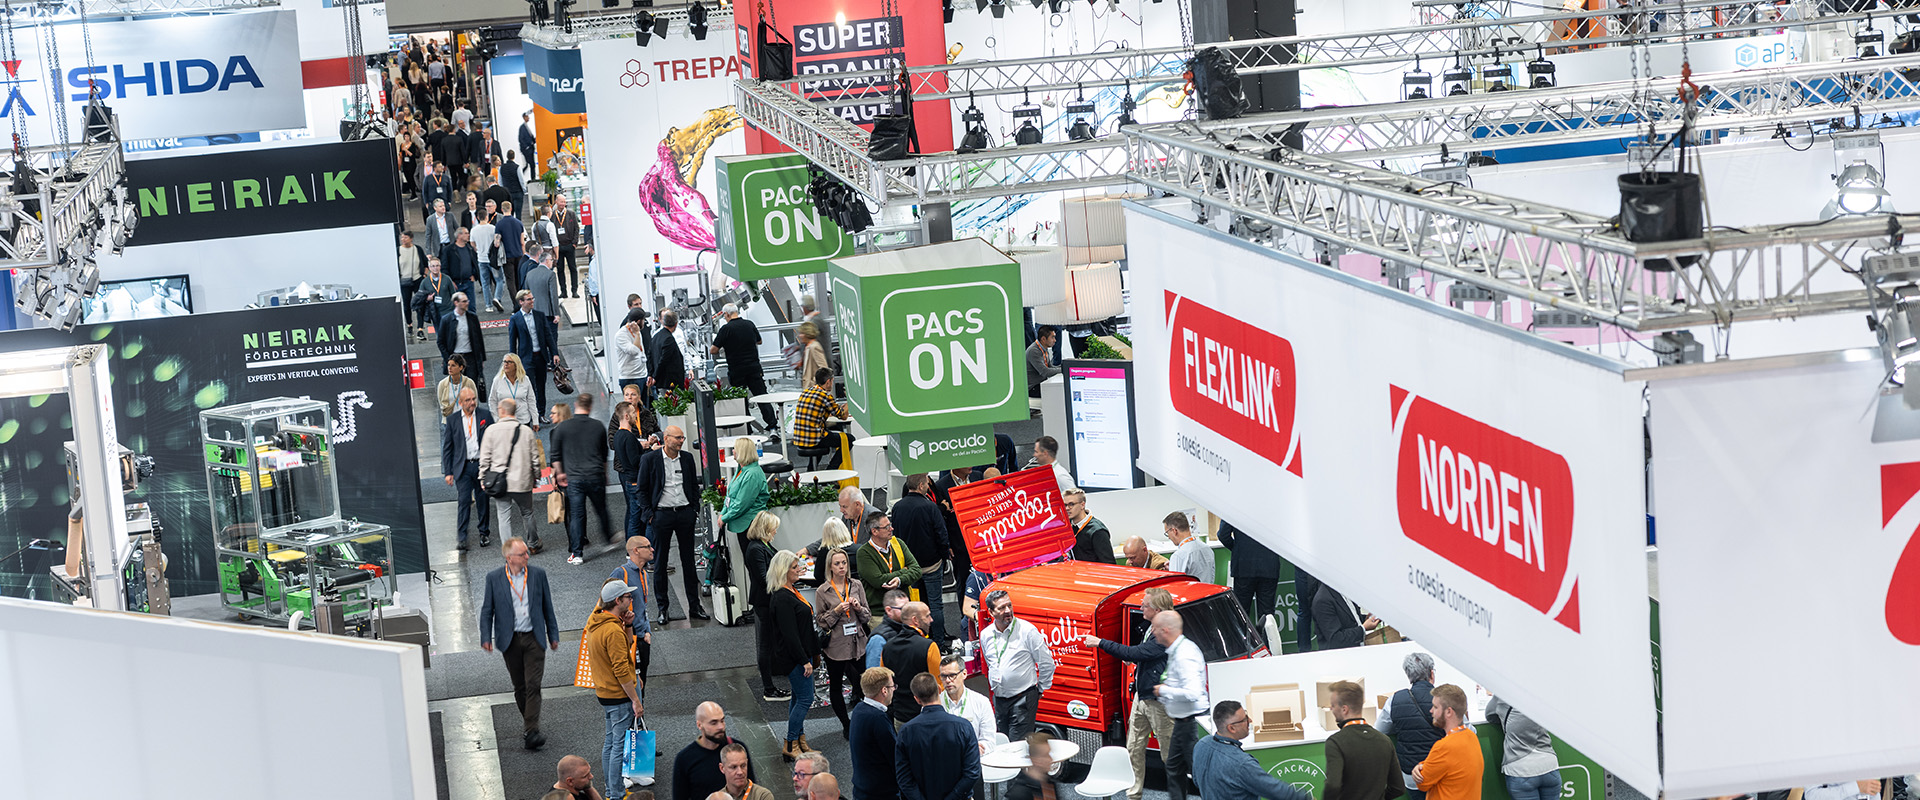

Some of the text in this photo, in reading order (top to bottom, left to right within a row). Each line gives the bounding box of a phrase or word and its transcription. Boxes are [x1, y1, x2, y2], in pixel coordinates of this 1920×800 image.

[799, 21, 892, 53] SUPER
[764, 206, 823, 246] ON
[839, 303, 857, 336] PACS
[906, 308, 984, 340] PACS
[245, 343, 356, 361] FÖRDERTECHNIK
[843, 334, 862, 387] ON
[909, 338, 988, 390] ON
[247, 366, 359, 383] EXPERTS IN VERTICAL CONVEYING
[928, 434, 987, 455] pacudo
[1177, 432, 1231, 482] a coesia company
[987, 485, 1016, 507] ANYWHERE
[1417, 433, 1545, 573] NORDEN
[976, 499, 1013, 526] GREAT COFFEE
[1408, 565, 1493, 638] a coesia company
[1277, 764, 1318, 777] PACKAR
